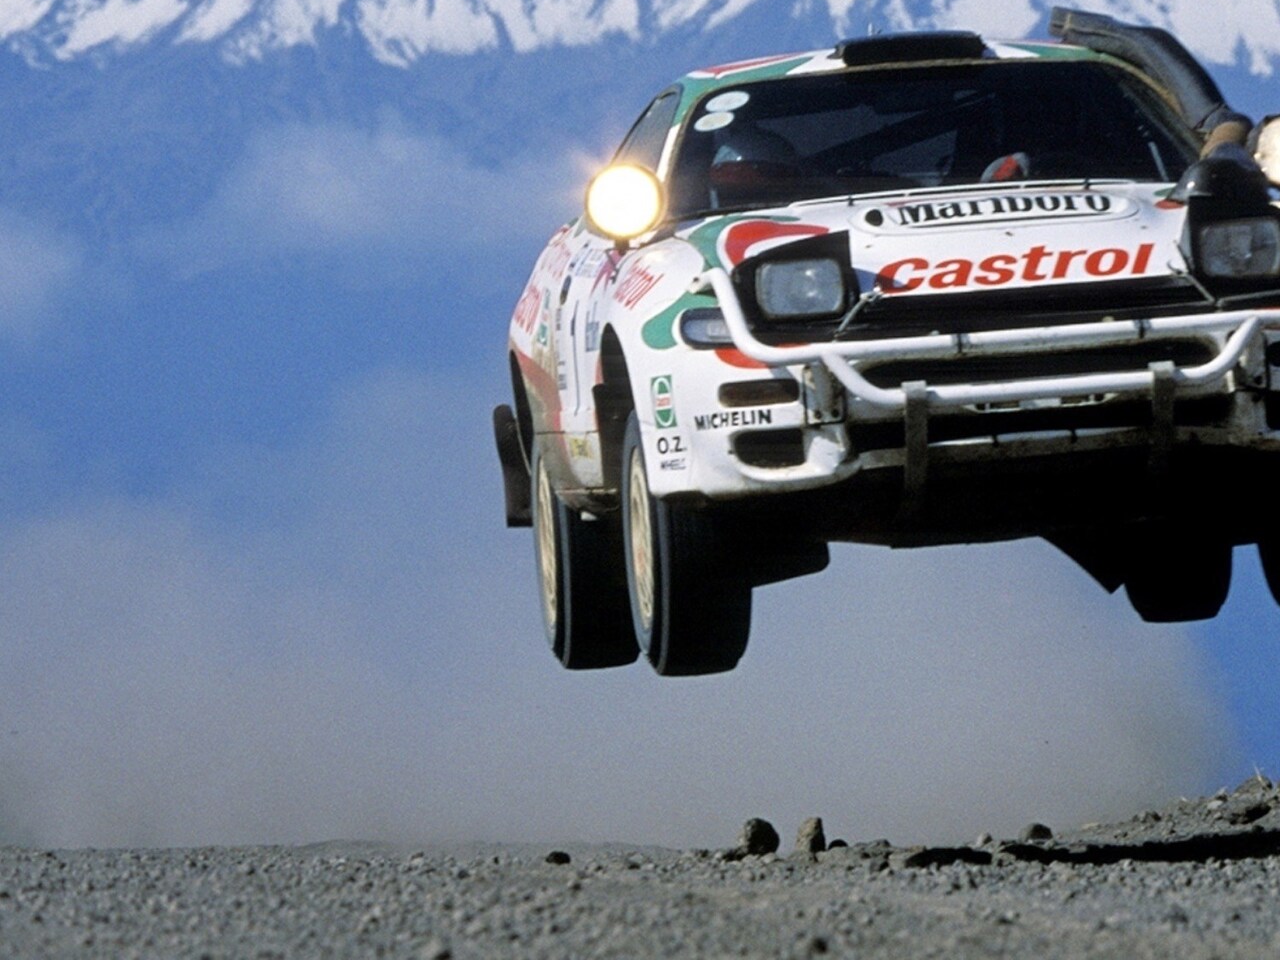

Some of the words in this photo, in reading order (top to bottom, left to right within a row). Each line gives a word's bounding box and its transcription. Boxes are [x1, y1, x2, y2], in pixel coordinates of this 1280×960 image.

[899, 193, 1112, 226] Marlboro
[874, 243, 1166, 294] Castrol
[694, 408, 773, 431] MICHELIN
